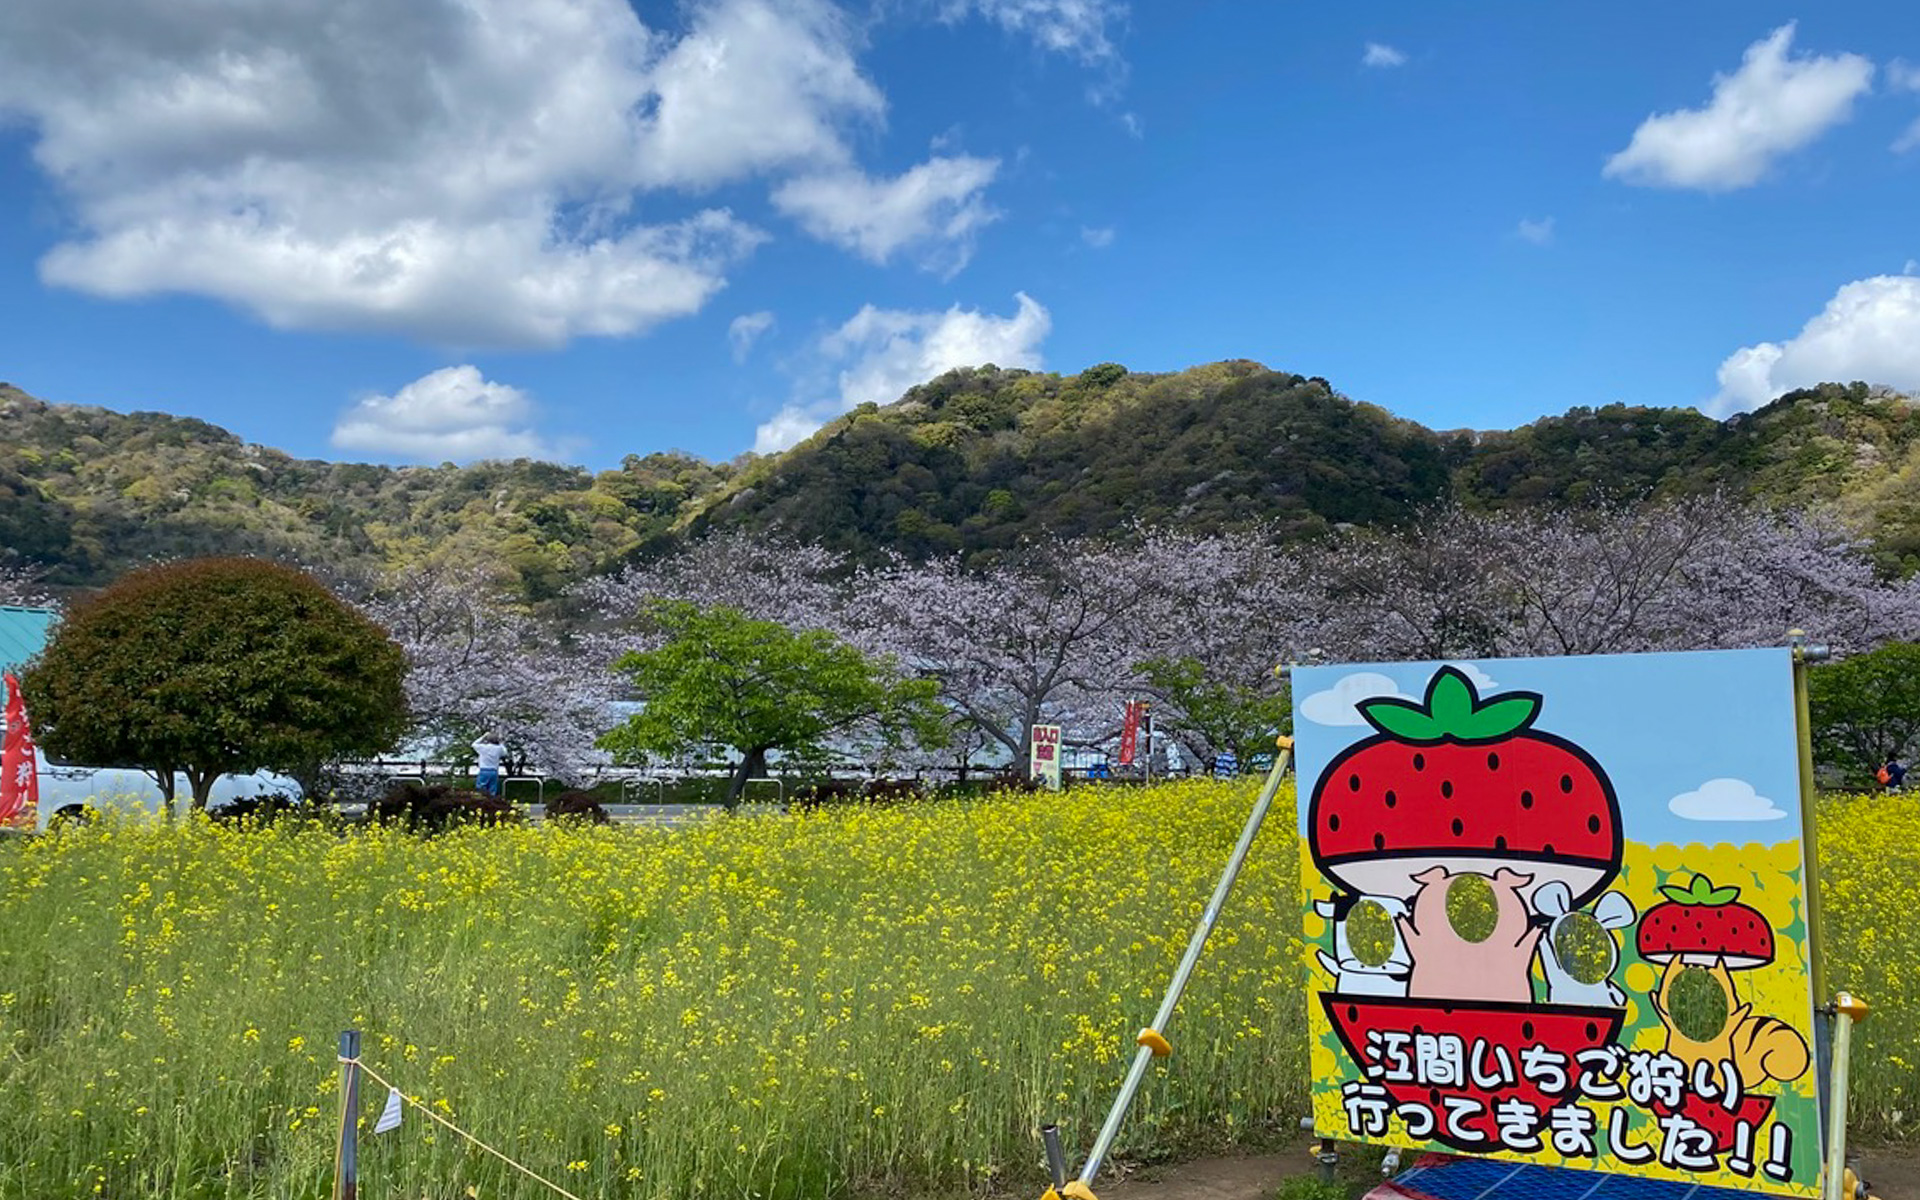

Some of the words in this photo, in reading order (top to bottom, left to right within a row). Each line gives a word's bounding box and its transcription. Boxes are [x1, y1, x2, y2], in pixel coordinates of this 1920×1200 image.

[1365, 1029, 1741, 1111] 江間いちご狩り
[1342, 1082, 1793, 1179] 行ってきました!!
